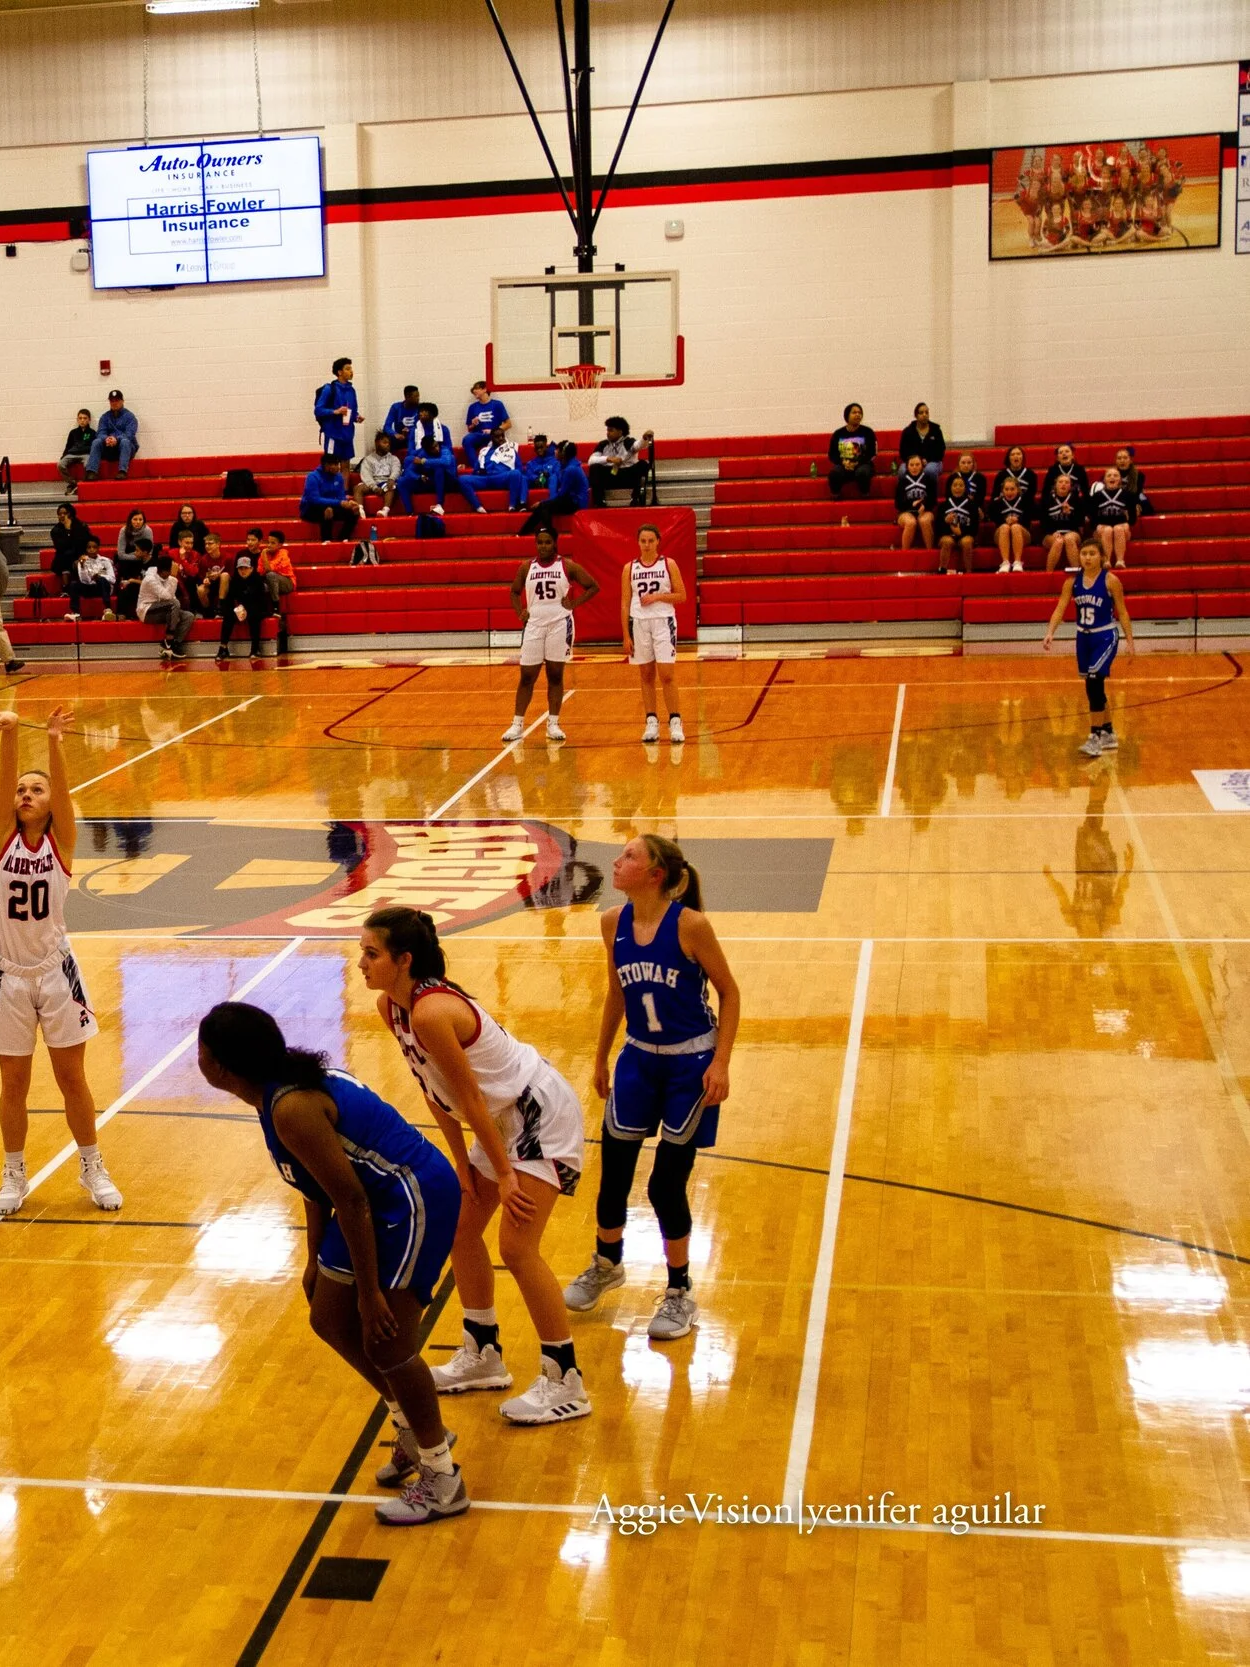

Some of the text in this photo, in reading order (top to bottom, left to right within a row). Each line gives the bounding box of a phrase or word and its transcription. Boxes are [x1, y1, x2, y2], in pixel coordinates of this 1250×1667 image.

[139, 153, 263, 172] Auto-Owners
[167, 170, 235, 180] INSURANCE
[146, 197, 265, 216] Harris-Fowler
[162, 217, 250, 233] Insurance
[529, 570, 562, 581] ALBERTVILLE
[632, 570, 665, 580] ALBERTVILLE
[534, 581, 557, 600] 45
[637, 581, 660, 598] 22
[1080, 607, 1095, 625] 15
[8, 879, 50, 921] 20
[617, 961, 680, 989] ETOWAH
[642, 992, 663, 1033] 1
